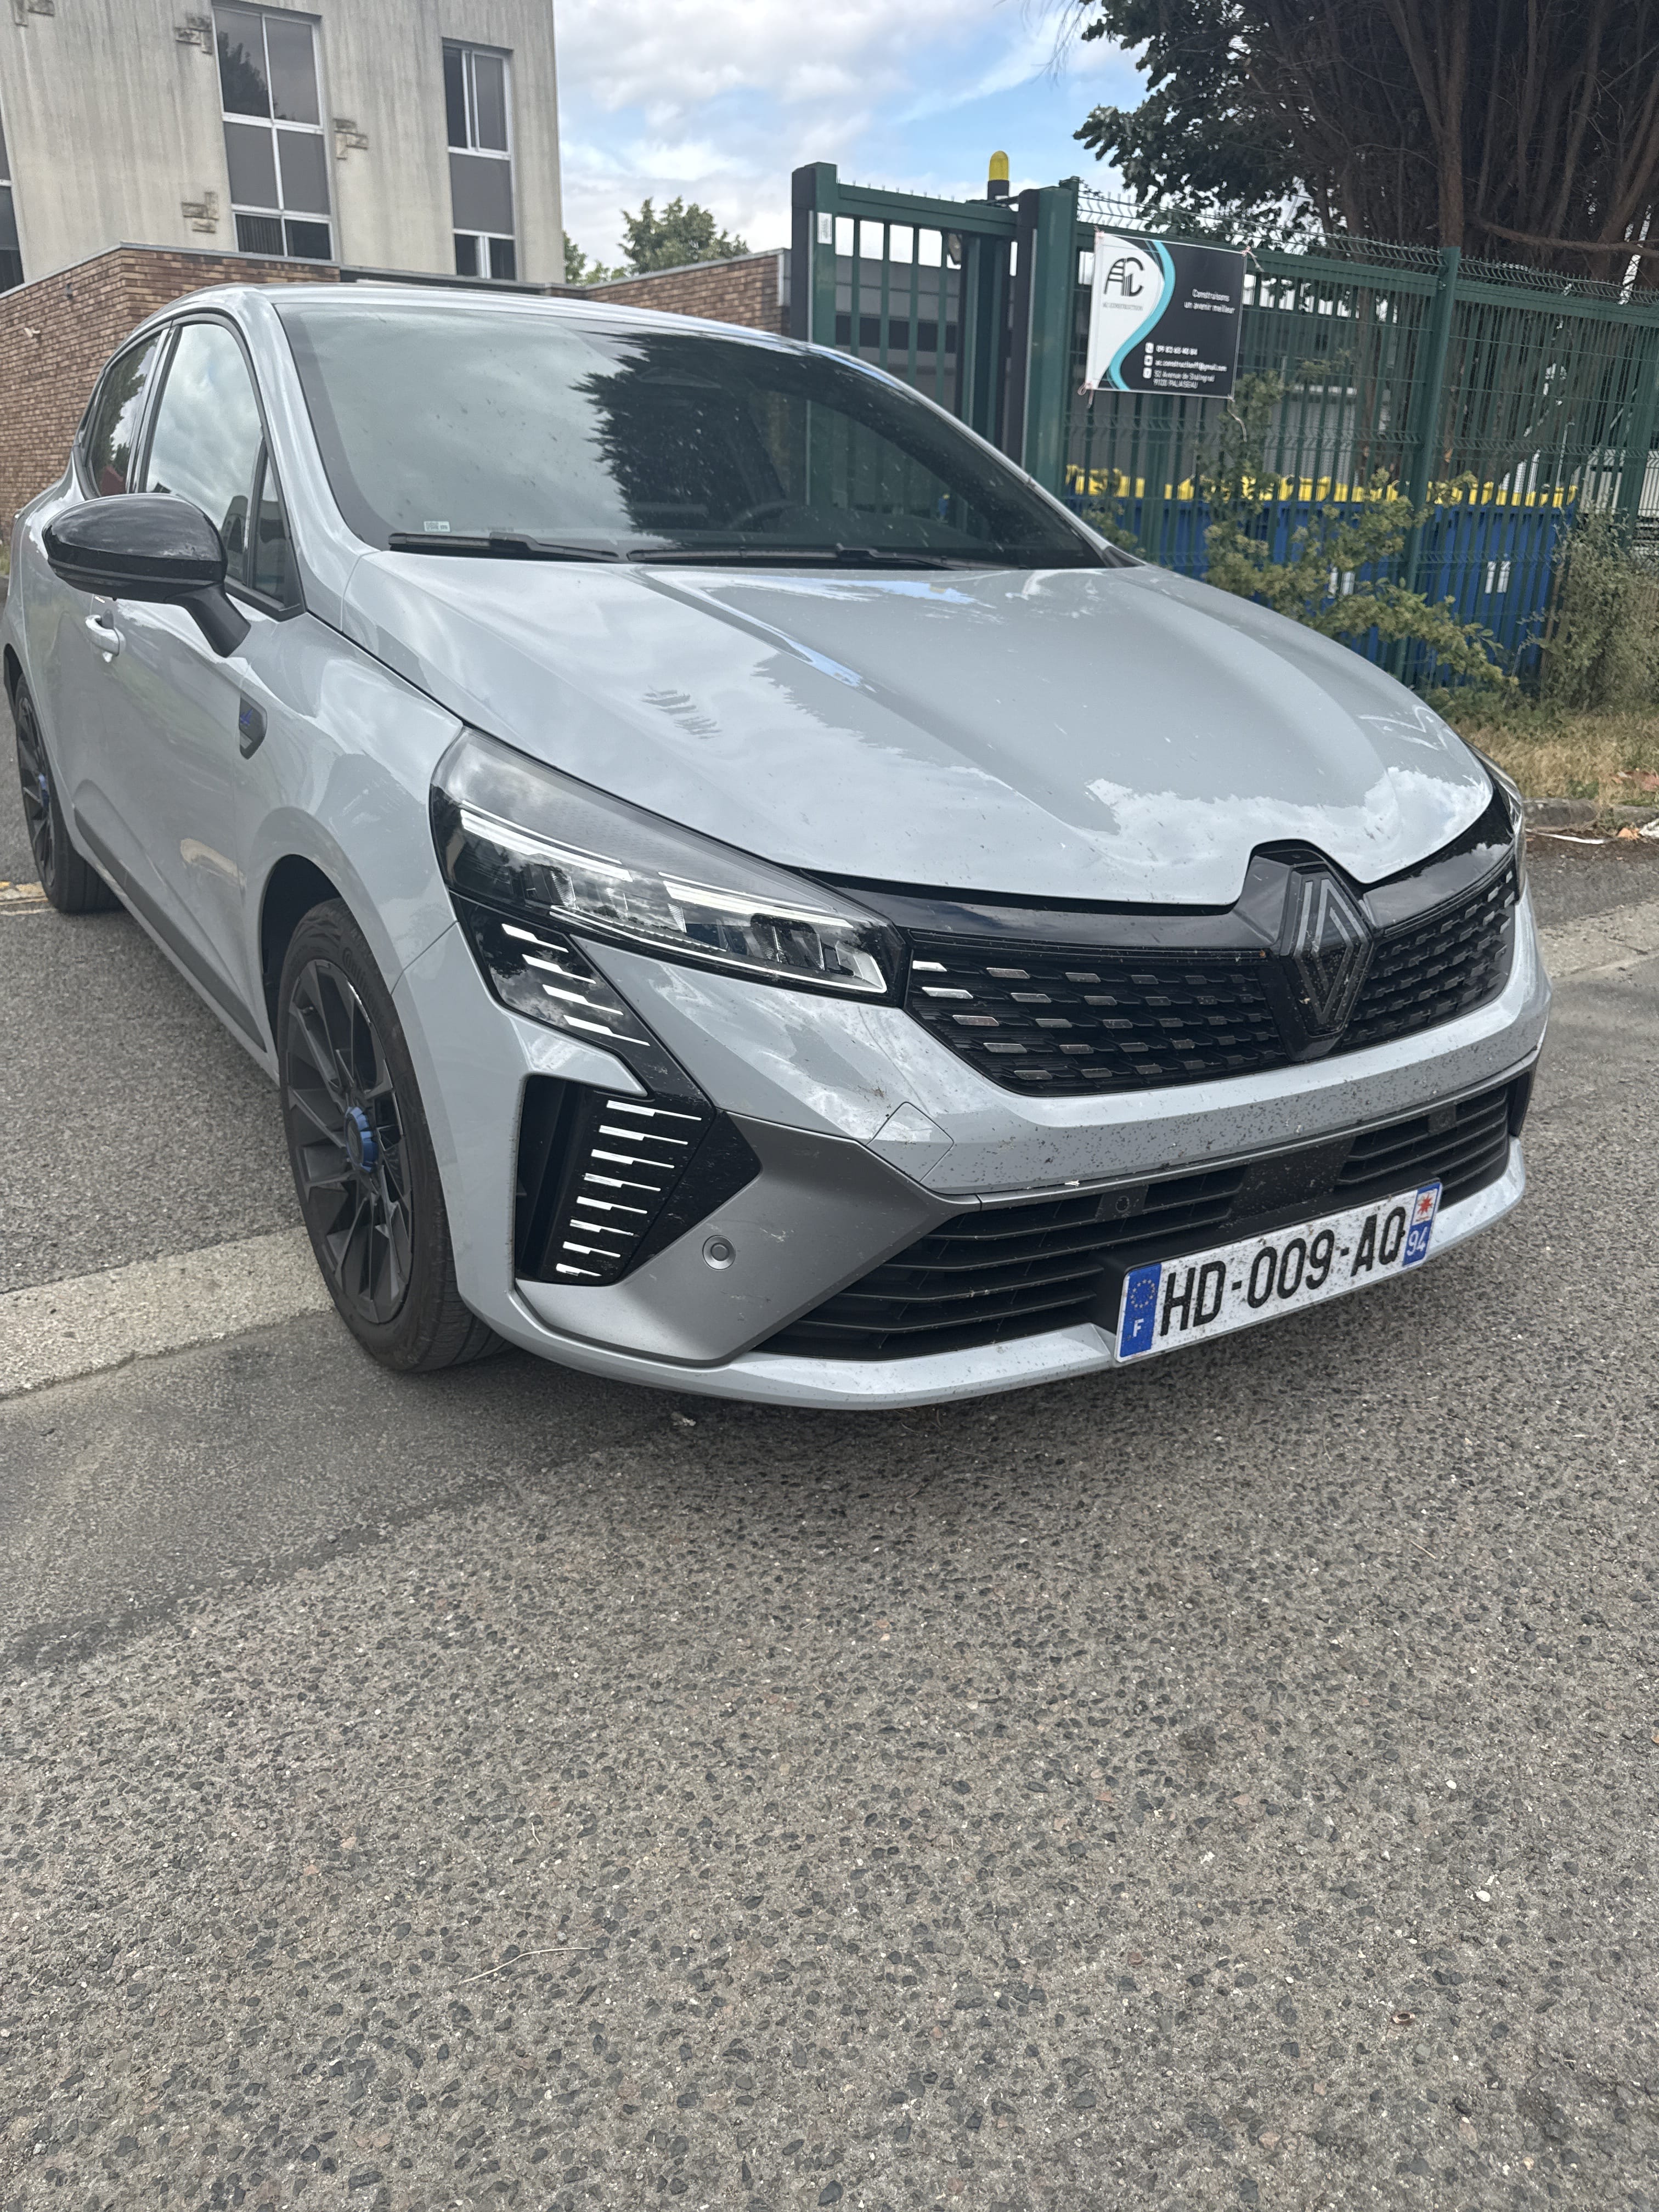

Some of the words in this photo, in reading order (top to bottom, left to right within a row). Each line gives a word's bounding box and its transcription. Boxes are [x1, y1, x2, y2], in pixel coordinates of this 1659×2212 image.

[1133, 1318, 1144, 1338] F
[1160, 1206, 1406, 1336] HD-009-AQ
[1406, 1226, 1428, 1256] 94
